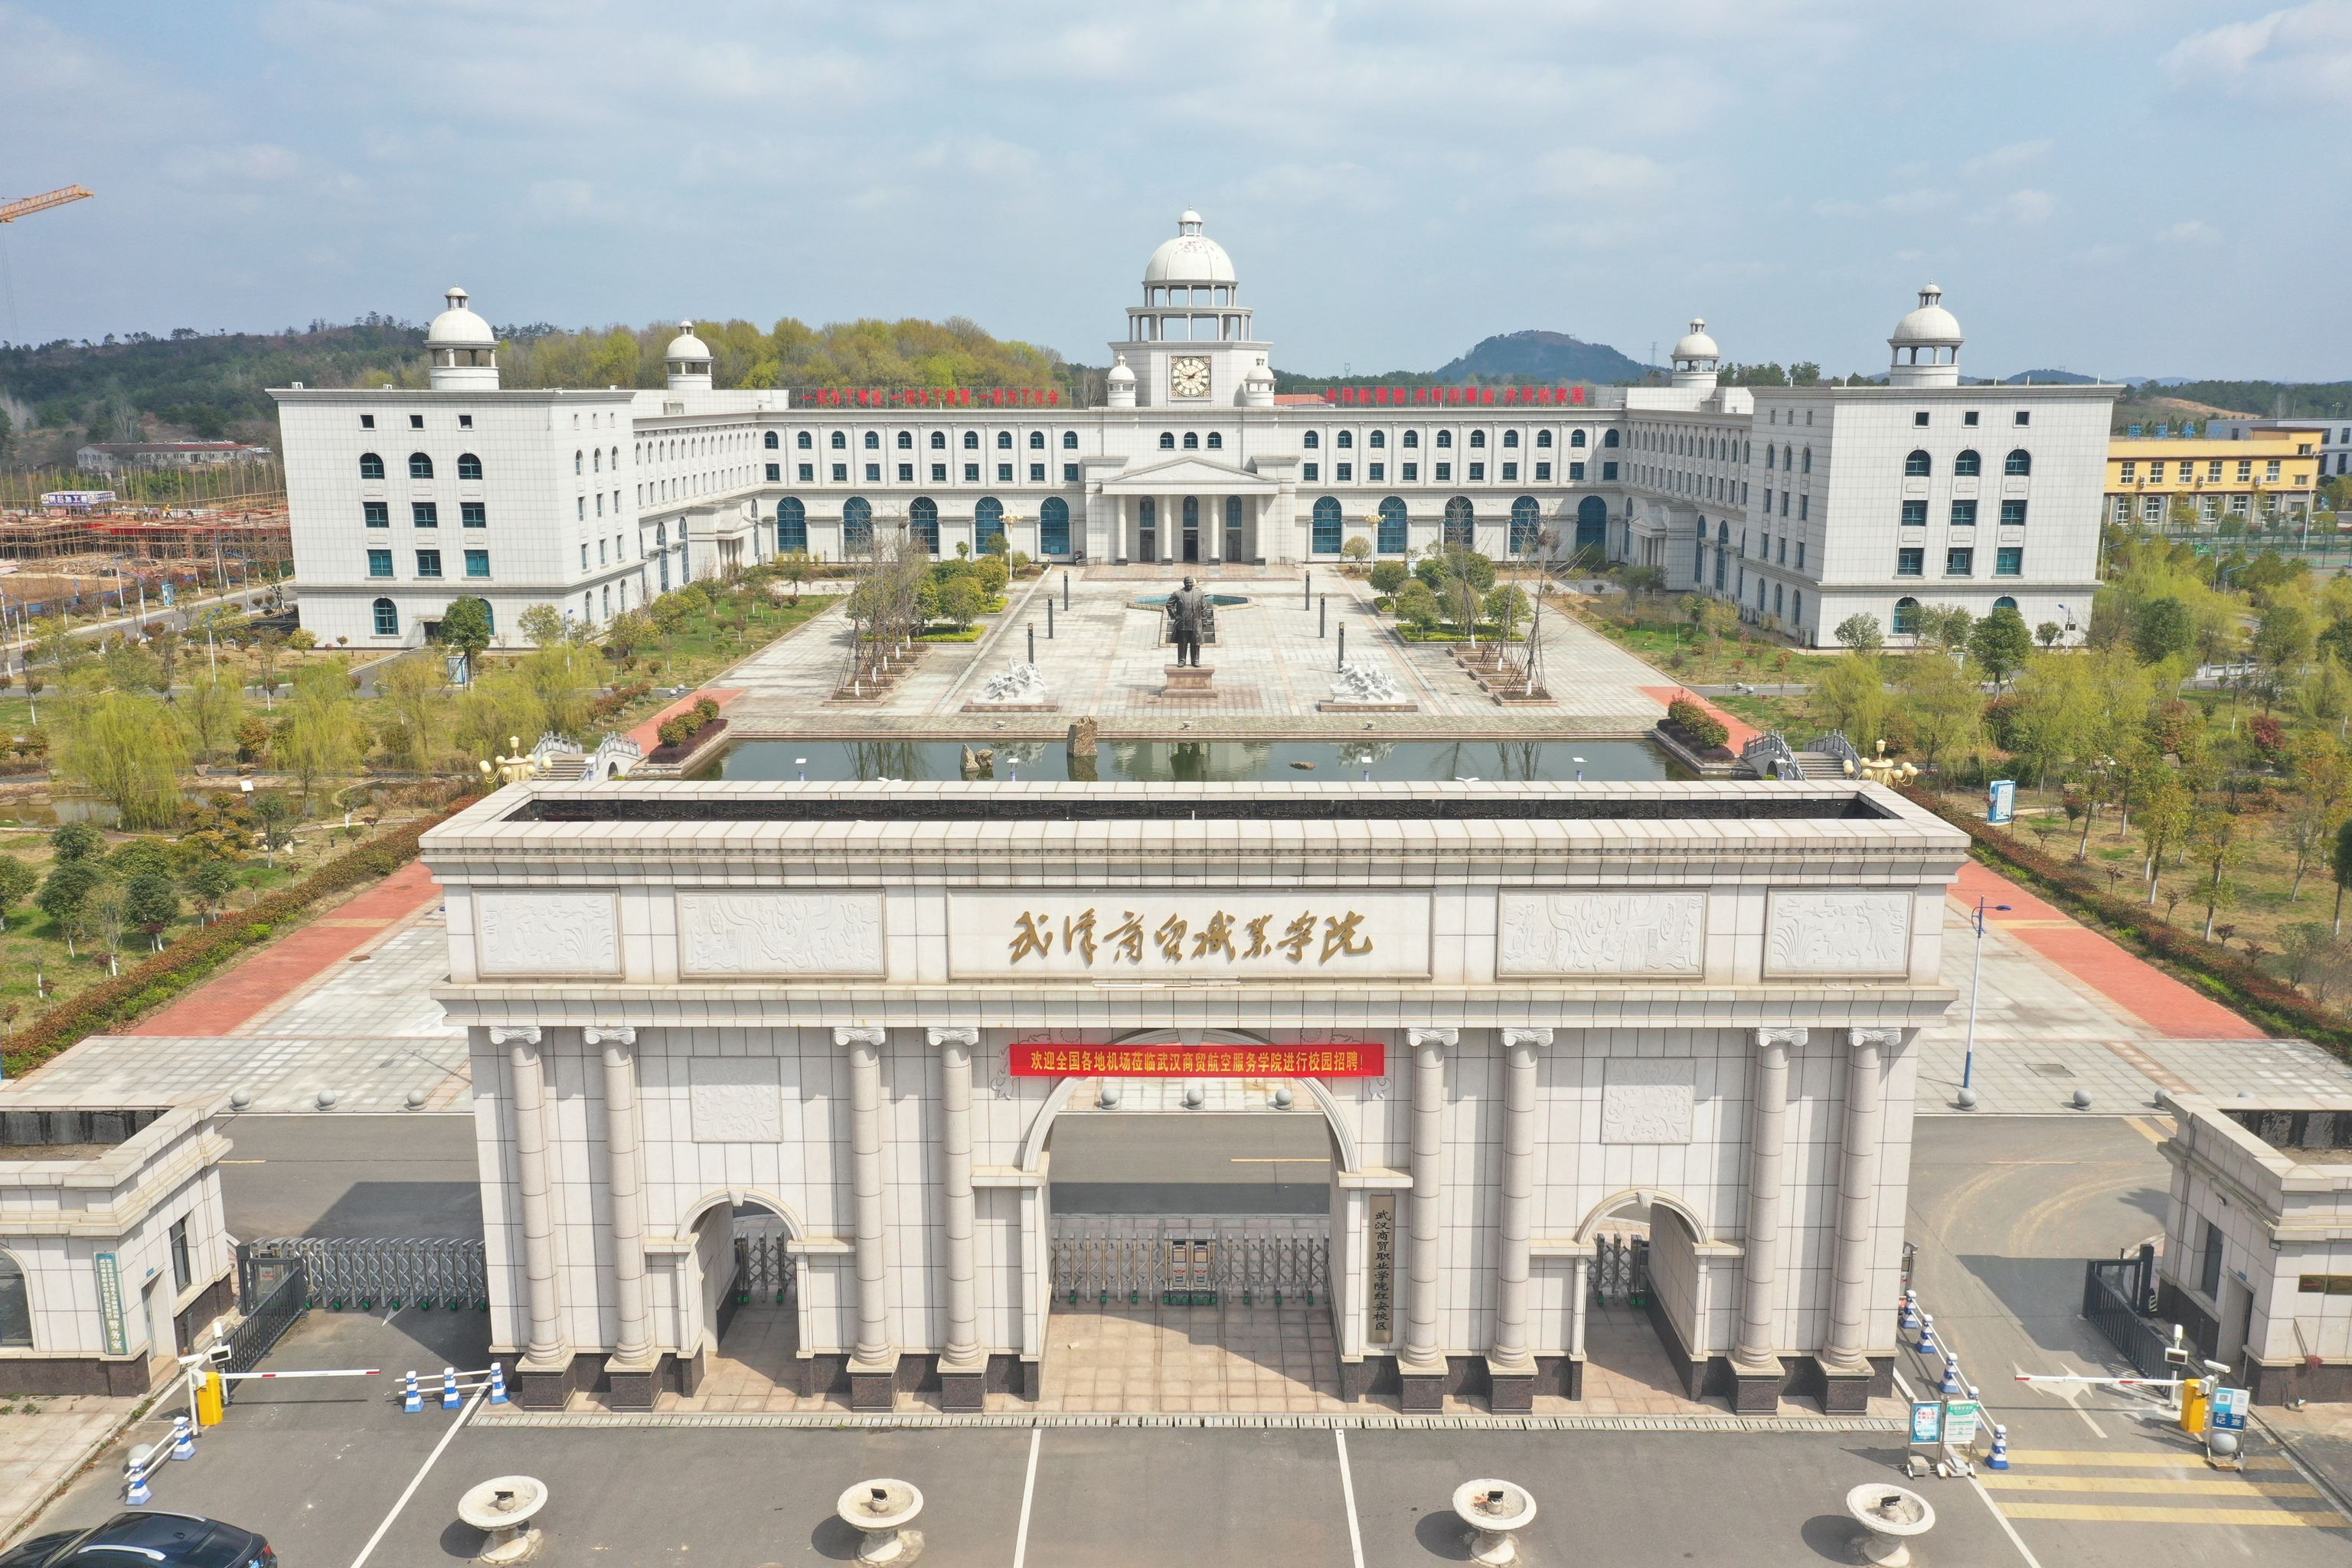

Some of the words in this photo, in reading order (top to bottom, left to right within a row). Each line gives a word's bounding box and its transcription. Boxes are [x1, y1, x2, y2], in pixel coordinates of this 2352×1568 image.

[1373, 1210, 1392, 1331] 武汉商贸职业学院红安校区
[109, 1319, 122, 1349] 警务室
